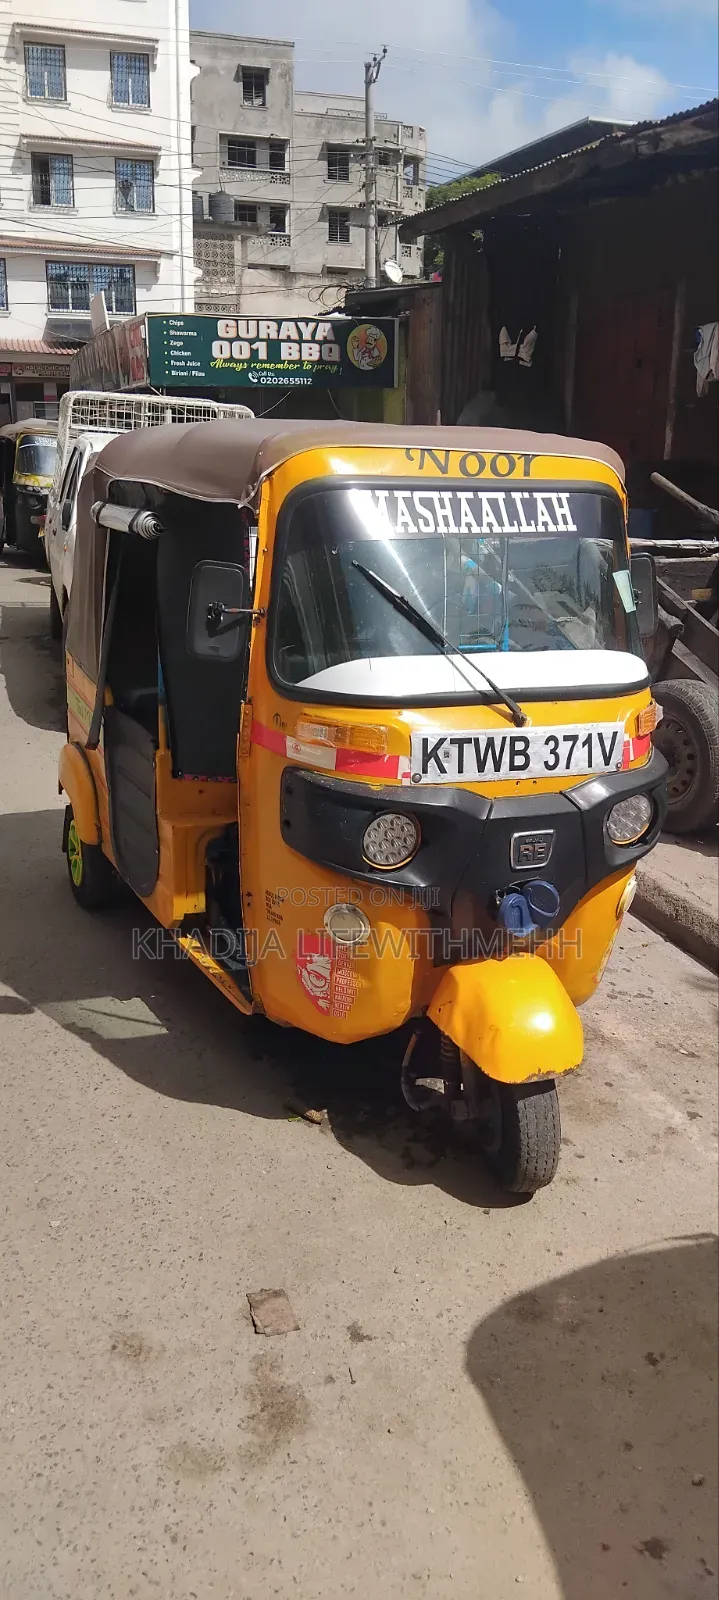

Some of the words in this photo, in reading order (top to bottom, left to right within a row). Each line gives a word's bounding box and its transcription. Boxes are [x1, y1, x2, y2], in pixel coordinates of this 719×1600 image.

[217, 319, 336, 341] GURAYA
[211, 340, 268, 361] 001
[280, 342, 341, 362] BBQ
[210, 359, 248, 371] Always
[250, 360, 300, 371] remember
[302, 360, 313, 371] to
[260, 377, 313, 385] 0202655112
[422, 735, 531, 775] KTWB
[544, 730, 619, 771] 371V
[519, 842, 547, 862] RE
